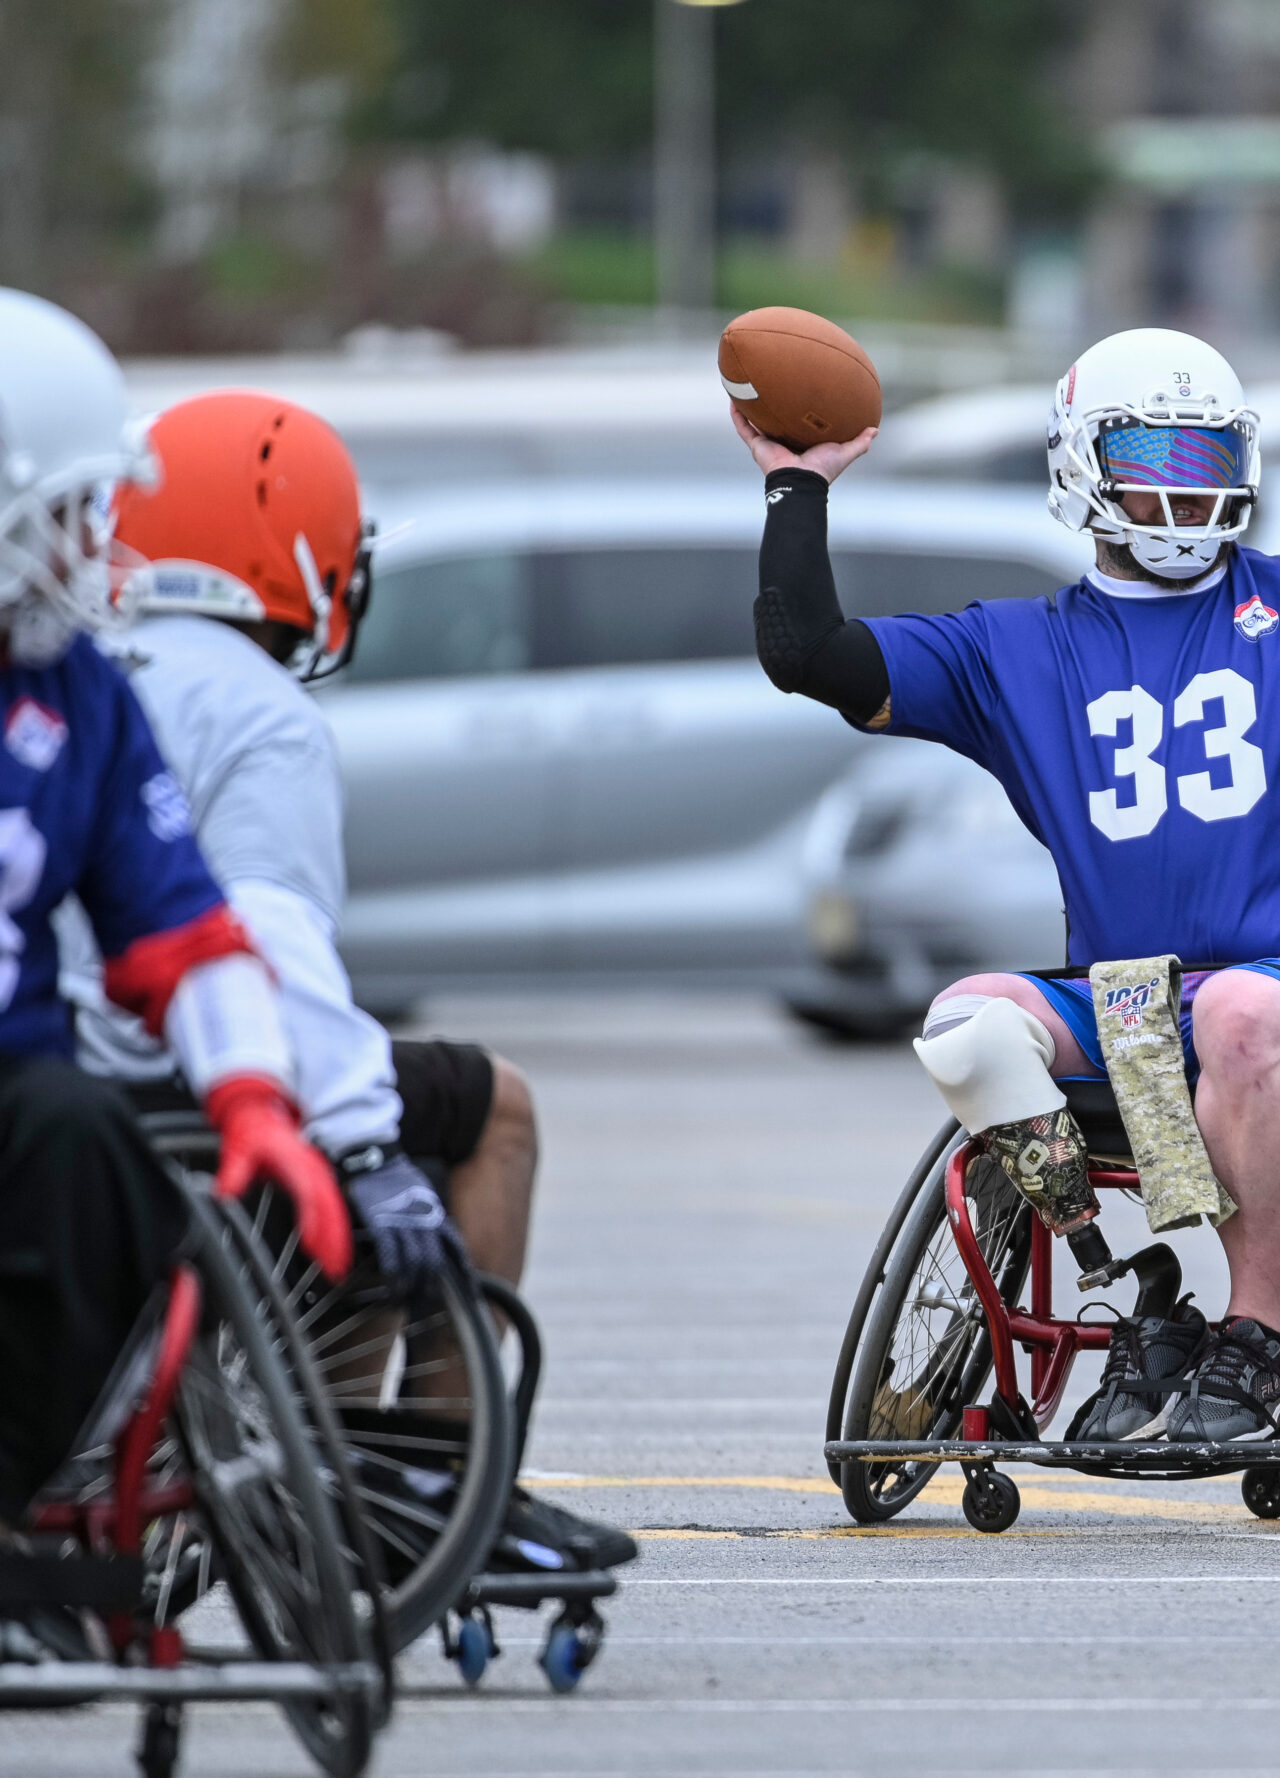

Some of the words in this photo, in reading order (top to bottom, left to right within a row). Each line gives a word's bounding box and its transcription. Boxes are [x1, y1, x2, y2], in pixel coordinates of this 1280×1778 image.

[1173, 372, 1191, 384] 33
[1086, 667, 1267, 842] 33
[1106, 984, 1150, 1009] 100
[1123, 1014, 1139, 1027] NFL
[1112, 1033, 1155, 1050] Wilson
[1261, 1378, 1279, 1399] FILA
